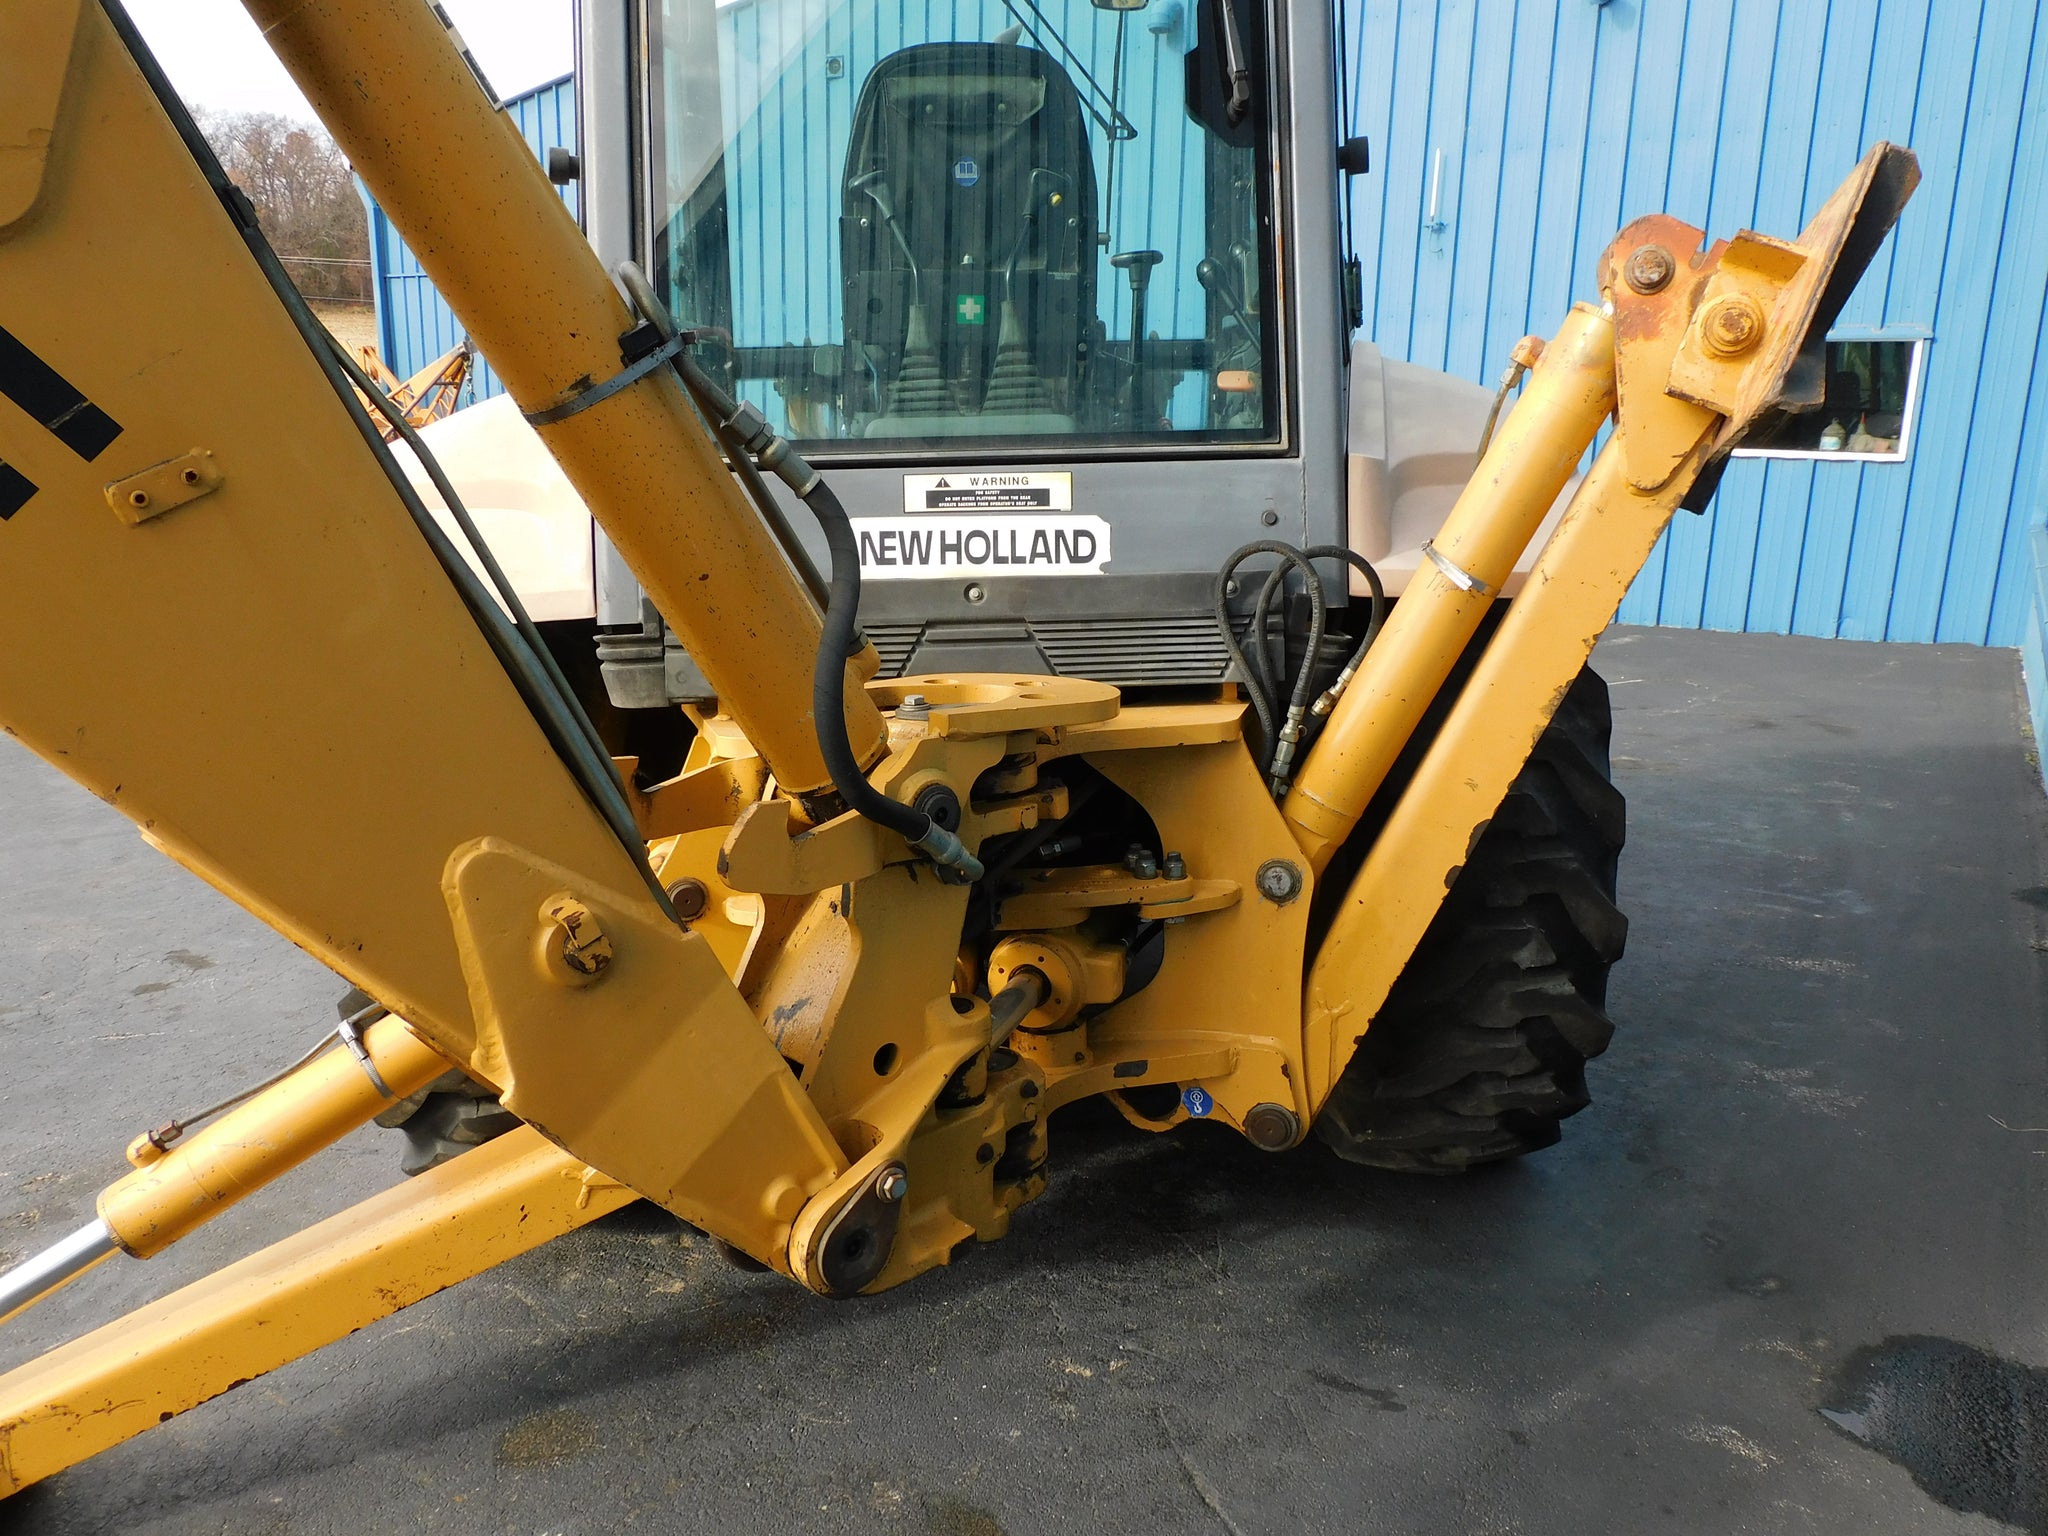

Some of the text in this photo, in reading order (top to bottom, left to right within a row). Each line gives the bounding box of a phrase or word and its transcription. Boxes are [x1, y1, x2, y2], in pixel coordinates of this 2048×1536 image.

[969, 476, 1029, 486] WARNING
[860, 529, 1097, 566] NEW HOLLAND
